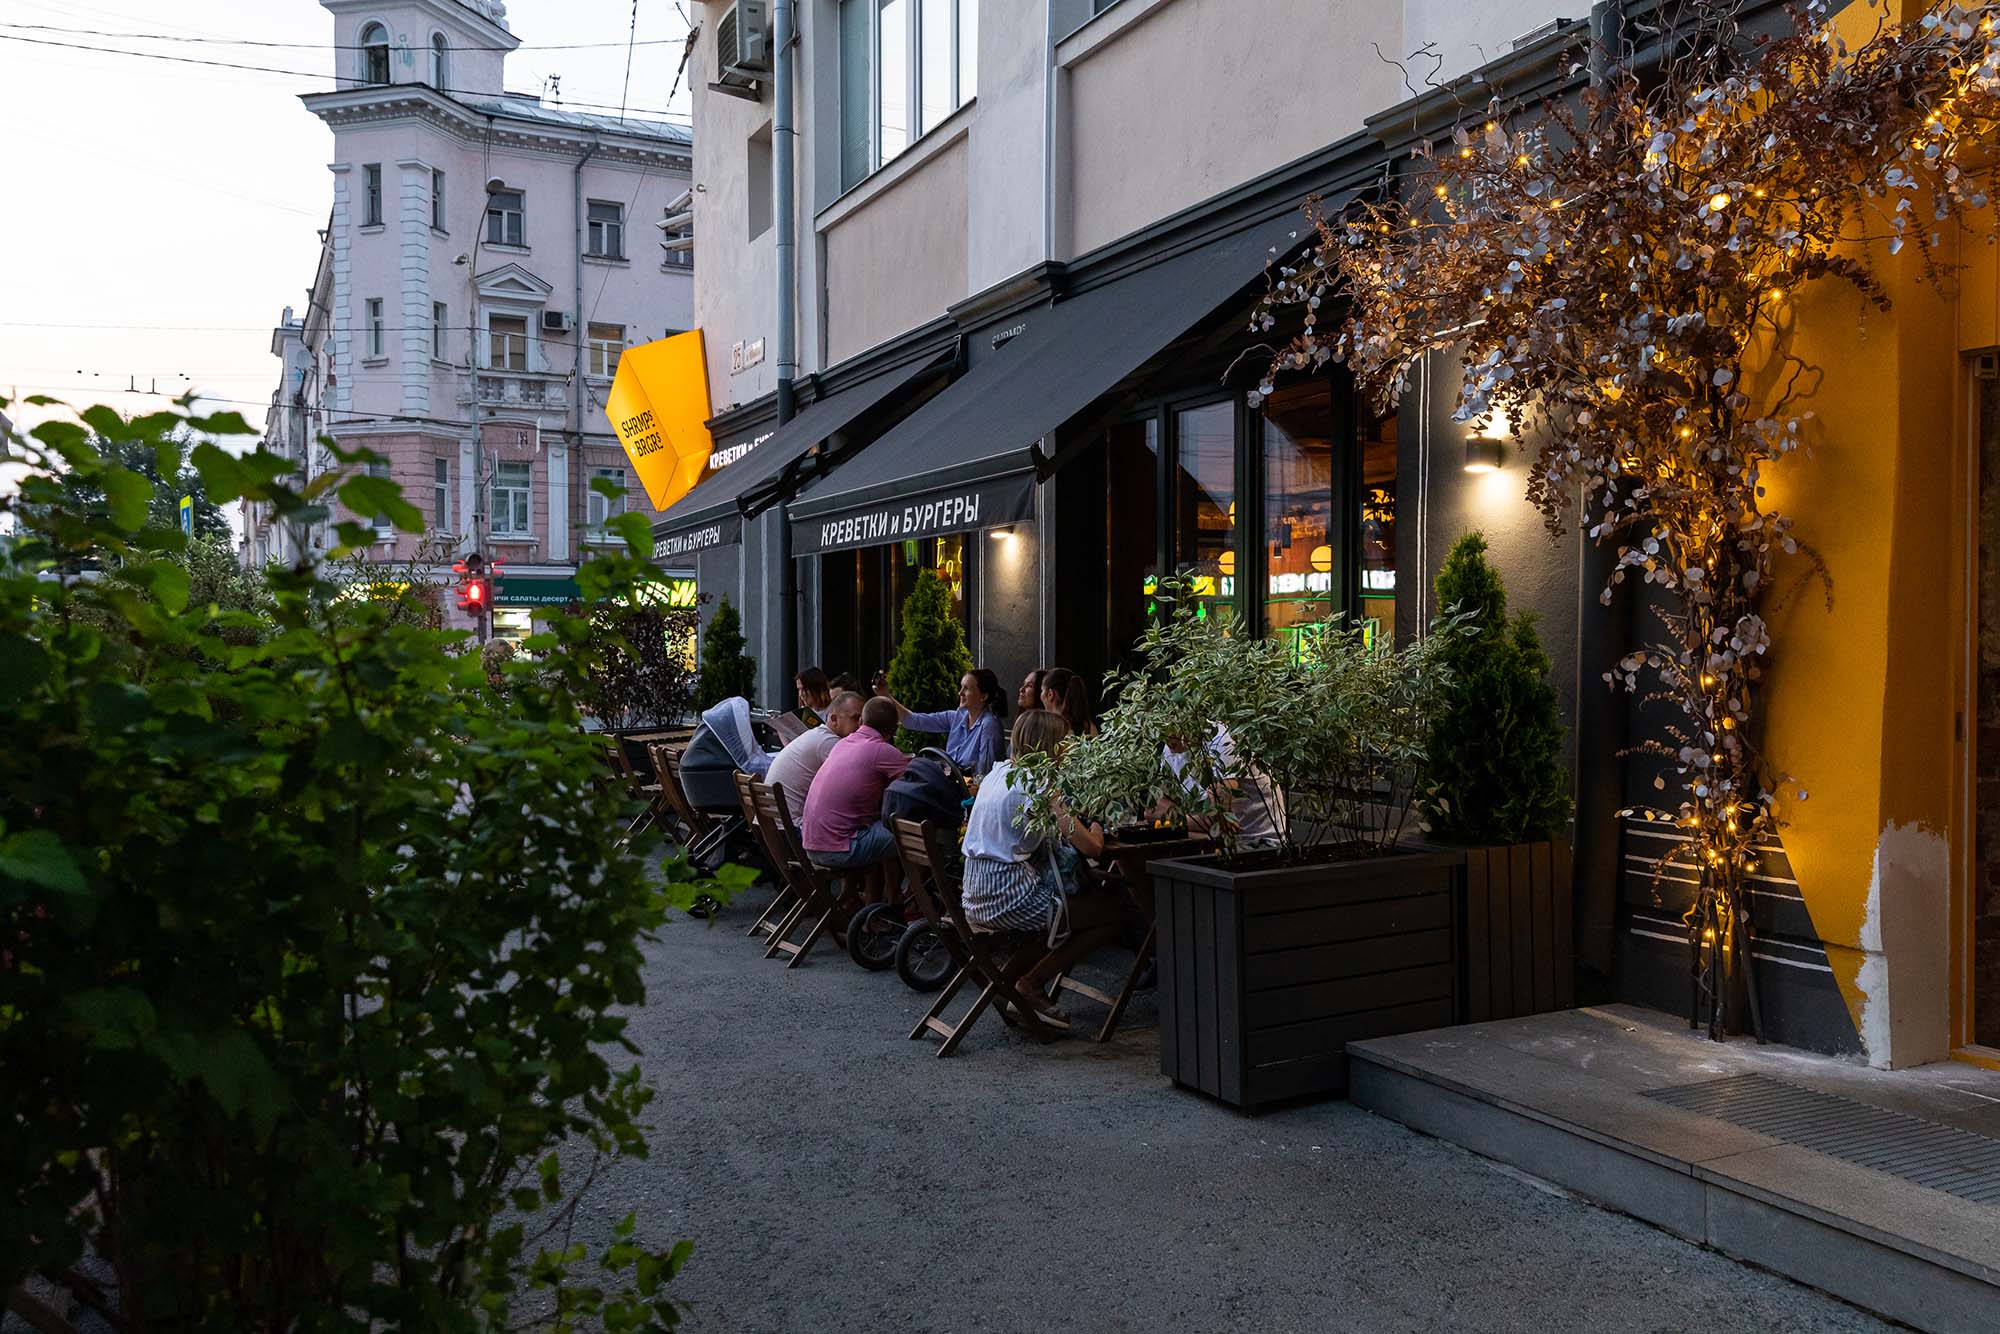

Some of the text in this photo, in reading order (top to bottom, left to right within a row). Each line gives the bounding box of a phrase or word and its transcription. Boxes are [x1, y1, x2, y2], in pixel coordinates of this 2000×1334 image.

[709, 442, 748, 470] КРЕВЕТКИ
[820, 493, 980, 547] КРЕВЕТКИ и БУРГЕРЫ
[687, 524, 721, 552] БУРГЕРЫ
[541, 595, 569, 605] десерт
